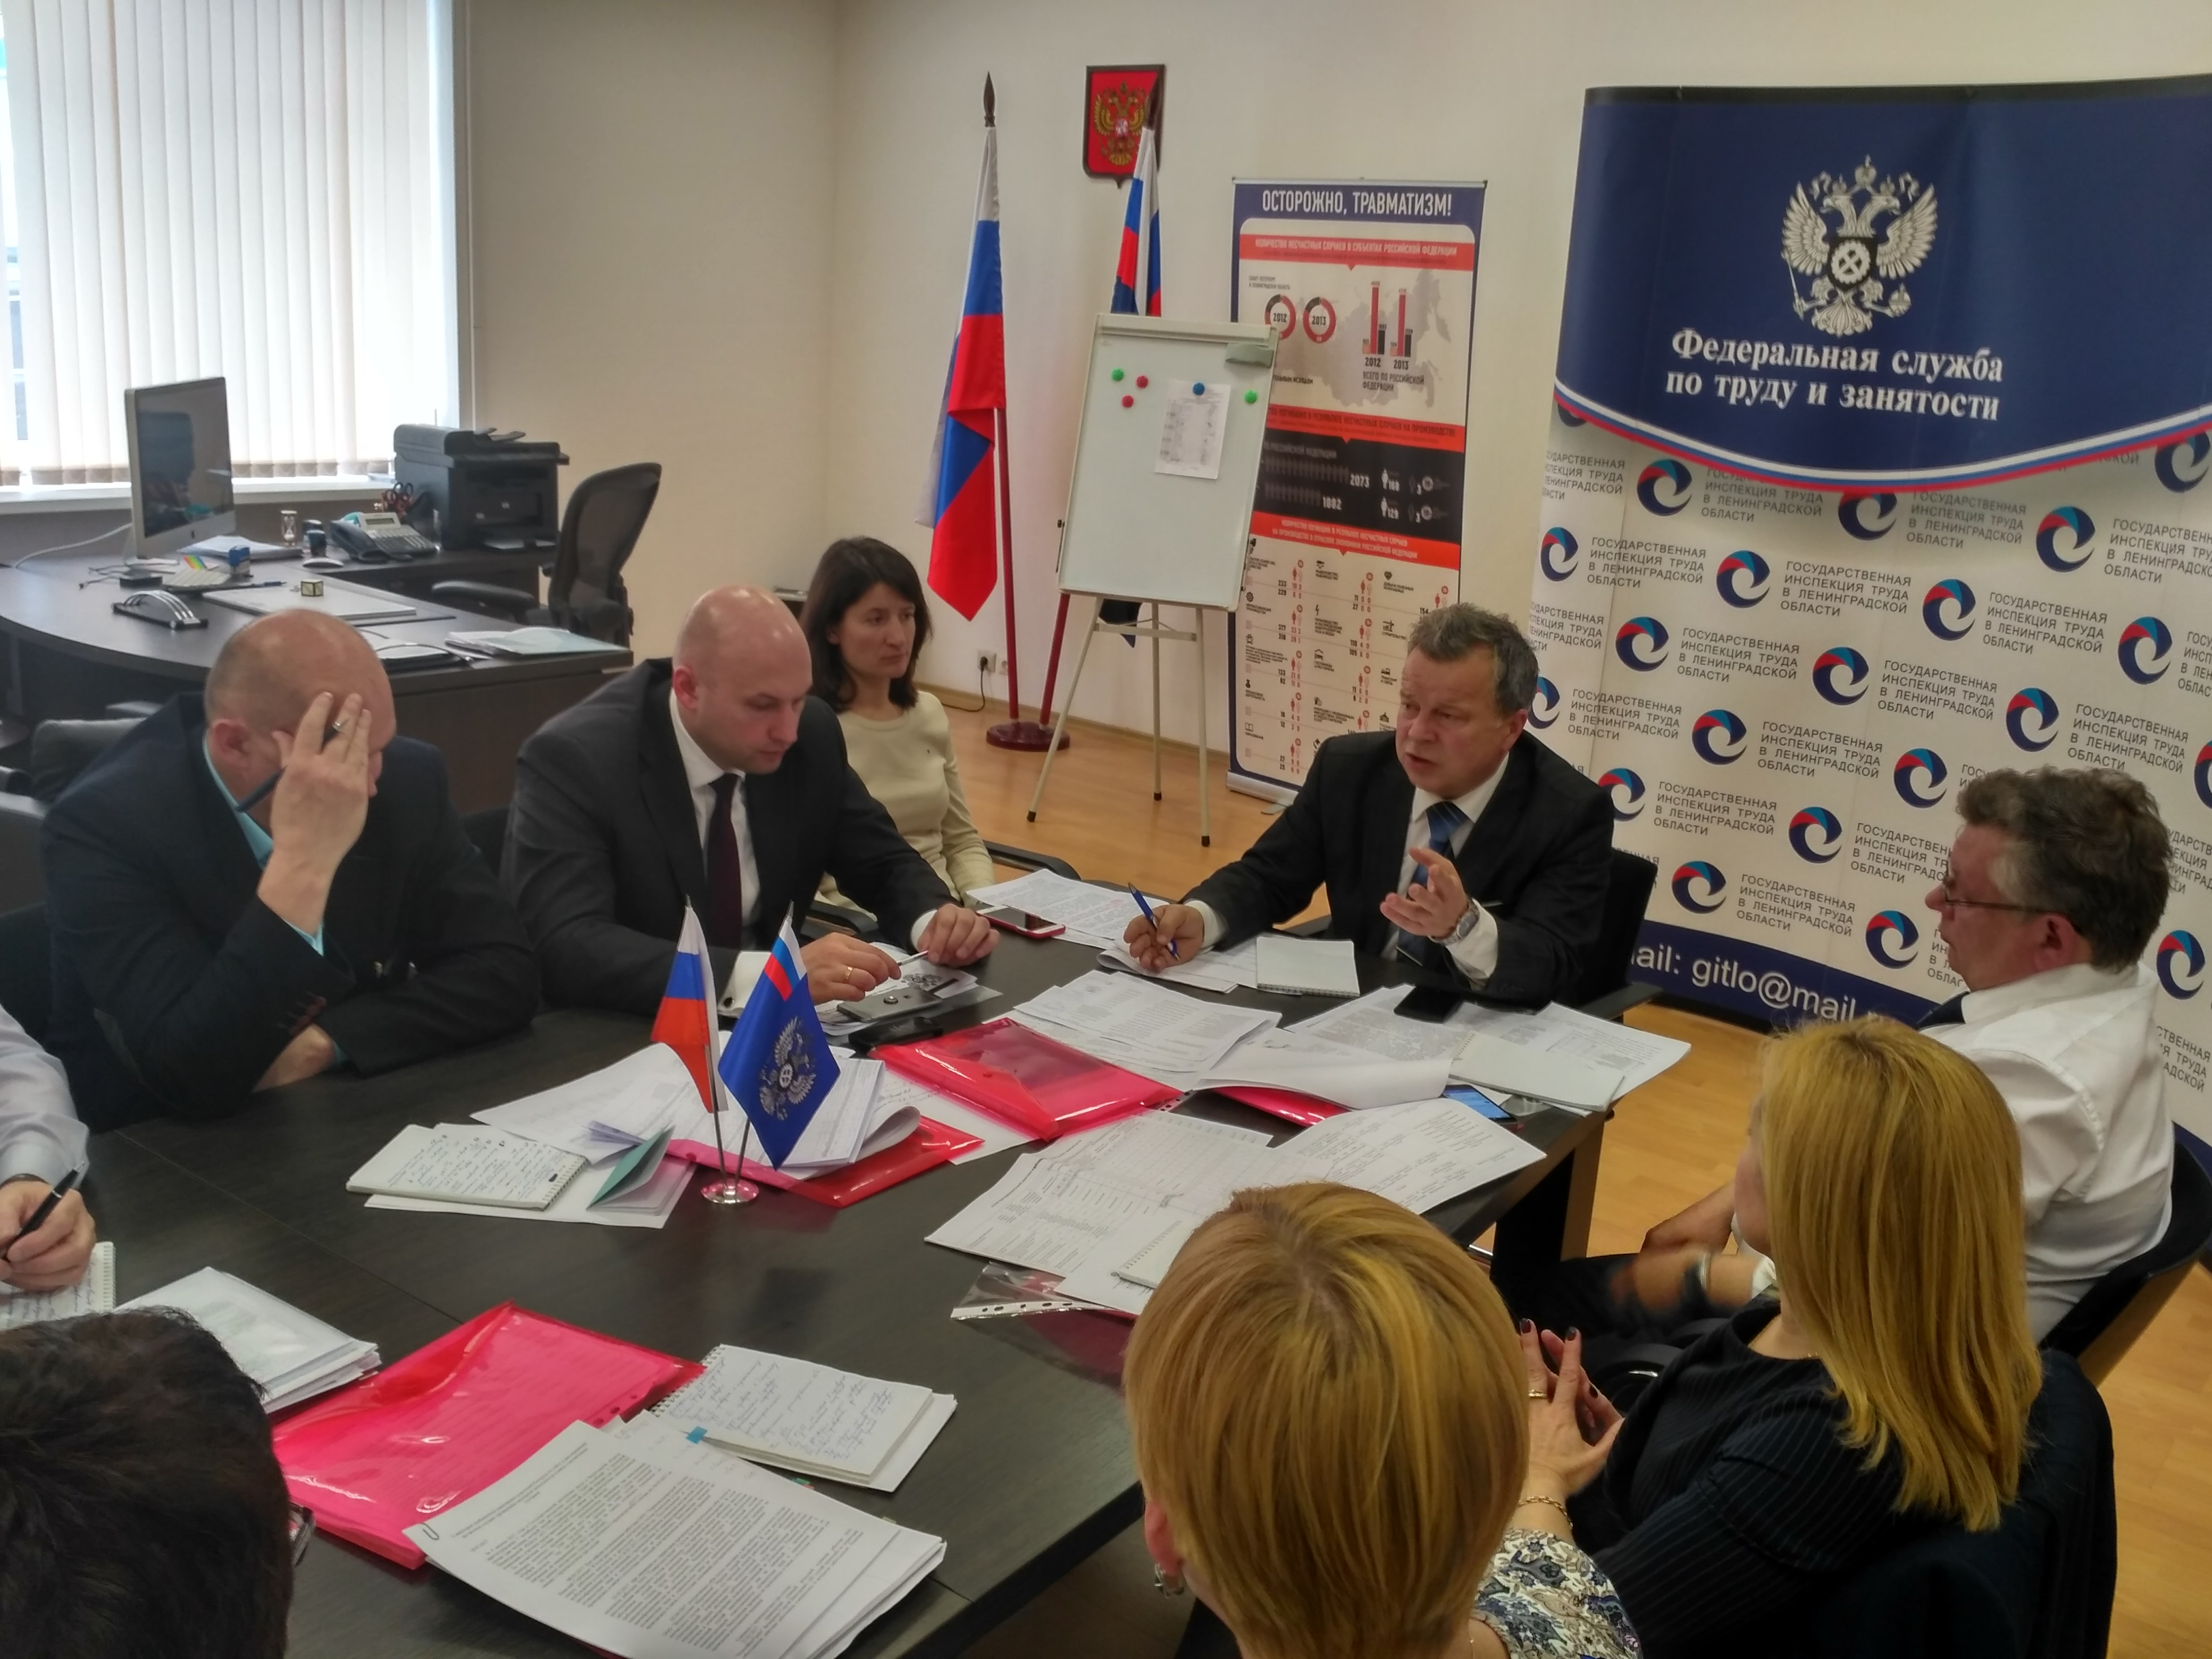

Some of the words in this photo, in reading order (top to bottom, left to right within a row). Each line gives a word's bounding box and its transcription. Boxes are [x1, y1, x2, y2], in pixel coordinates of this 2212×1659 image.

[1263, 190, 1347, 215] ОСТОРОЖНО,
[1353, 191, 1452, 216] ТРАВМАТИЗМ!
[1273, 313, 1287, 322] 2012
[1312, 315, 1326, 325] 2013
[1365, 357, 1381, 367] 2012
[1394, 359, 1409, 370] 2013
[1672, 327, 1880, 372] Федеральная
[1892, 347, 2003, 383] служба
[1362, 381, 1394, 391] ФЕДЕРАЦИИ
[1363, 371, 1378, 380] ВСЕГО
[1389, 374, 1424, 385] РОССИЙСКОЙ
[1665, 371, 1702, 396] по
[1714, 374, 1798, 409] труду
[1807, 381, 1828, 406] и
[1839, 383, 2000, 421] занятости
[1350, 473, 1370, 488] 2073
[1546, 475, 1622, 494] ЕНИНГРАДСКОЙ
[1589, 471, 1623, 483] ТРУДА
[1704, 494, 1710, 503] В
[1717, 496, 1821, 516] ЛЕНИНГРАДСКОЙ
[1705, 482, 1776, 498] ИНСПЕКЦИЯ
[1785, 490, 1823, 504] ТРУДА
[1702, 507, 1754, 522] ОБЛАСТИ
[1912, 505, 1984, 523] ИНСПЕКЦИЯ
[1991, 515, 2023, 530] ТРУДА
[1907, 532, 1963, 548] ОБЛАСТИ
[1909, 518, 1916, 528] В
[1925, 520, 2022, 544] ЛЕНИНГРАДСКОЙ
[2113, 519, 2212, 544] ГОСУДАРСТВЕНН
[1592, 537, 1706, 558] ГОСУДАРСТВЕННАЯ
[2110, 534, 2185, 555] ИНСПЕКЦИЯ
[2193, 547, 2212, 560] ТРУ
[1589, 562, 1595, 571] В
[1603, 564, 1703, 583] ЛЕНИНГРАДСКОЙ
[1590, 550, 1662, 565] ИНСПЕКЦИЯ
[1670, 558, 1704, 572] ТРУДА
[2105, 564, 2161, 583] ОБЛАСТИ
[2107, 549, 2115, 559] В
[2123, 551, 2212, 577] ЛЕНИНГРАДСКО
[1587, 574, 1640, 588] ОБЛАСТИ
[1787, 562, 1911, 586] ГОСУДАРСТВЕННАЯ
[1784, 575, 1863, 593] ИНСПЕКЦИЯ
[1872, 585, 1908, 600] ТРУДА
[1781, 601, 1840, 616] ОБЛАСТИ
[1782, 588, 1790, 597] В
[1799, 589, 1907, 613] ЛЕНИНГРАДСКОЙ
[1990, 592, 2107, 624] ГОСУДАРСТВЕННАЯ
[1570, 624, 1602, 638] ТРУДА
[1988, 607, 2056, 629] ИНСПЕКЦИЯ
[2065, 622, 2104, 639] ТРУДА
[1530, 625, 1602, 649] ЕНИНГРАДСКОЙ
[1683, 628, 1799, 654] ГОСУДАРСТВЕННАЯ
[1983, 634, 2033, 654] ОБЛАСТИ
[1985, 621, 1991, 630] В
[1998, 623, 2102, 653] ЛЕНИНГРАДСКОЙ
[1679, 653, 1686, 661] В
[1692, 655, 1796, 679] ЛЕНИНГРАДСКОЙ
[1681, 641, 1751, 660] ИНСПЕКЦИЯ
[1759, 653, 1797, 667] ТРУДА
[1678, 666, 1729, 682] ОБЛАСТИ
[1885, 660, 1997, 692] ГОСУДАРСТВЕННАЯ
[2181, 663, 2188, 673] В
[1883, 674, 1956, 697] ИНСПЕКЦИЯ
[1963, 690, 1995, 707] ТРУДА
[2178, 678, 2211, 697] ОБЛАС
[1571, 701, 1640, 719] ИНСПЕКЦИЯ
[1647, 713, 1679, 727] ТРУДА
[1573, 689, 1681, 715] ГОСУДАРСТВЕННАЯ
[1878, 700, 1934, 719] ОБЛАСТИ
[1880, 687, 1887, 696] В
[1895, 690, 1993, 720] ЛЕНИНГРАДСКОЙ
[1568, 725, 1619, 740] ОБЛАСТИ
[1570, 713, 1576, 721] В
[1582, 715, 1678, 739] ЛЕНИНГРАДСКОЙ
[2076, 704, 2188, 743] ГОСУДАРСТВЕННАЯ
[1763, 722, 1882, 752] ГОСУДАРСТВЕННАЯ
[2073, 718, 2147, 746] ИНСПЕКЦИЯ
[2155, 739, 2184, 759] ТРУДА
[1759, 747, 1766, 755] В
[1775, 749, 1879, 778] ЛЕНИНГРАДСКОЙ
[1761, 734, 1837, 756] ИНСПЕКЦИЯ
[1845, 749, 1880, 766] ТРУДА
[2068, 748, 2125, 769] ОБЛАСТИ
[2071, 733, 2078, 743] В
[2086, 736, 2183, 773] ЛЕНИНГРАДСКОЙ
[1758, 759, 1814, 776] ОБЛАСТИ
[1657, 793, 1729, 815] ИНСПЕКЦИЯ
[1738, 809, 1774, 823] ТРУДА
[1660, 781, 1777, 810] ГОСУДАРСТВЕННАЯ
[1654, 818, 1707, 835] ОБЛАСТИ
[1656, 805, 1662, 814] В
[1669, 808, 1773, 835] ЛЕНИНГРАДСКОЙ
[1855, 836, 1926, 862] ИНСПЕКЦИЯ
[1857, 823, 1950, 855] ГОСУДАРСТВЕН
[1851, 861, 1905, 883] ОБЛАСТИ
[1853, 848, 1859, 857] В
[1867, 852, 1944, 881] ЛЕНИНГРАДС
[1740, 886, 1812, 911] ИНСПЕКЦИЯ
[1819, 906, 1853, 925] ТРУДА
[1742, 874, 1855, 912] ГОСУДАРСТВЕННАЯ
[1737, 910, 1790, 931] ОБЛАСТИ
[1738, 898, 1745, 907] В
[1753, 902, 1851, 936] ЛЕНИНГРАДСКОЙ
[1930, 954, 1936, 964] В
[1631, 943, 1680, 975] ail:
[1692, 957, 1879, 1021] gitlo@mail
[1928, 968, 1963, 987] ОБЛАС
[2177, 1052, 2206, 1078] ТРУДА
